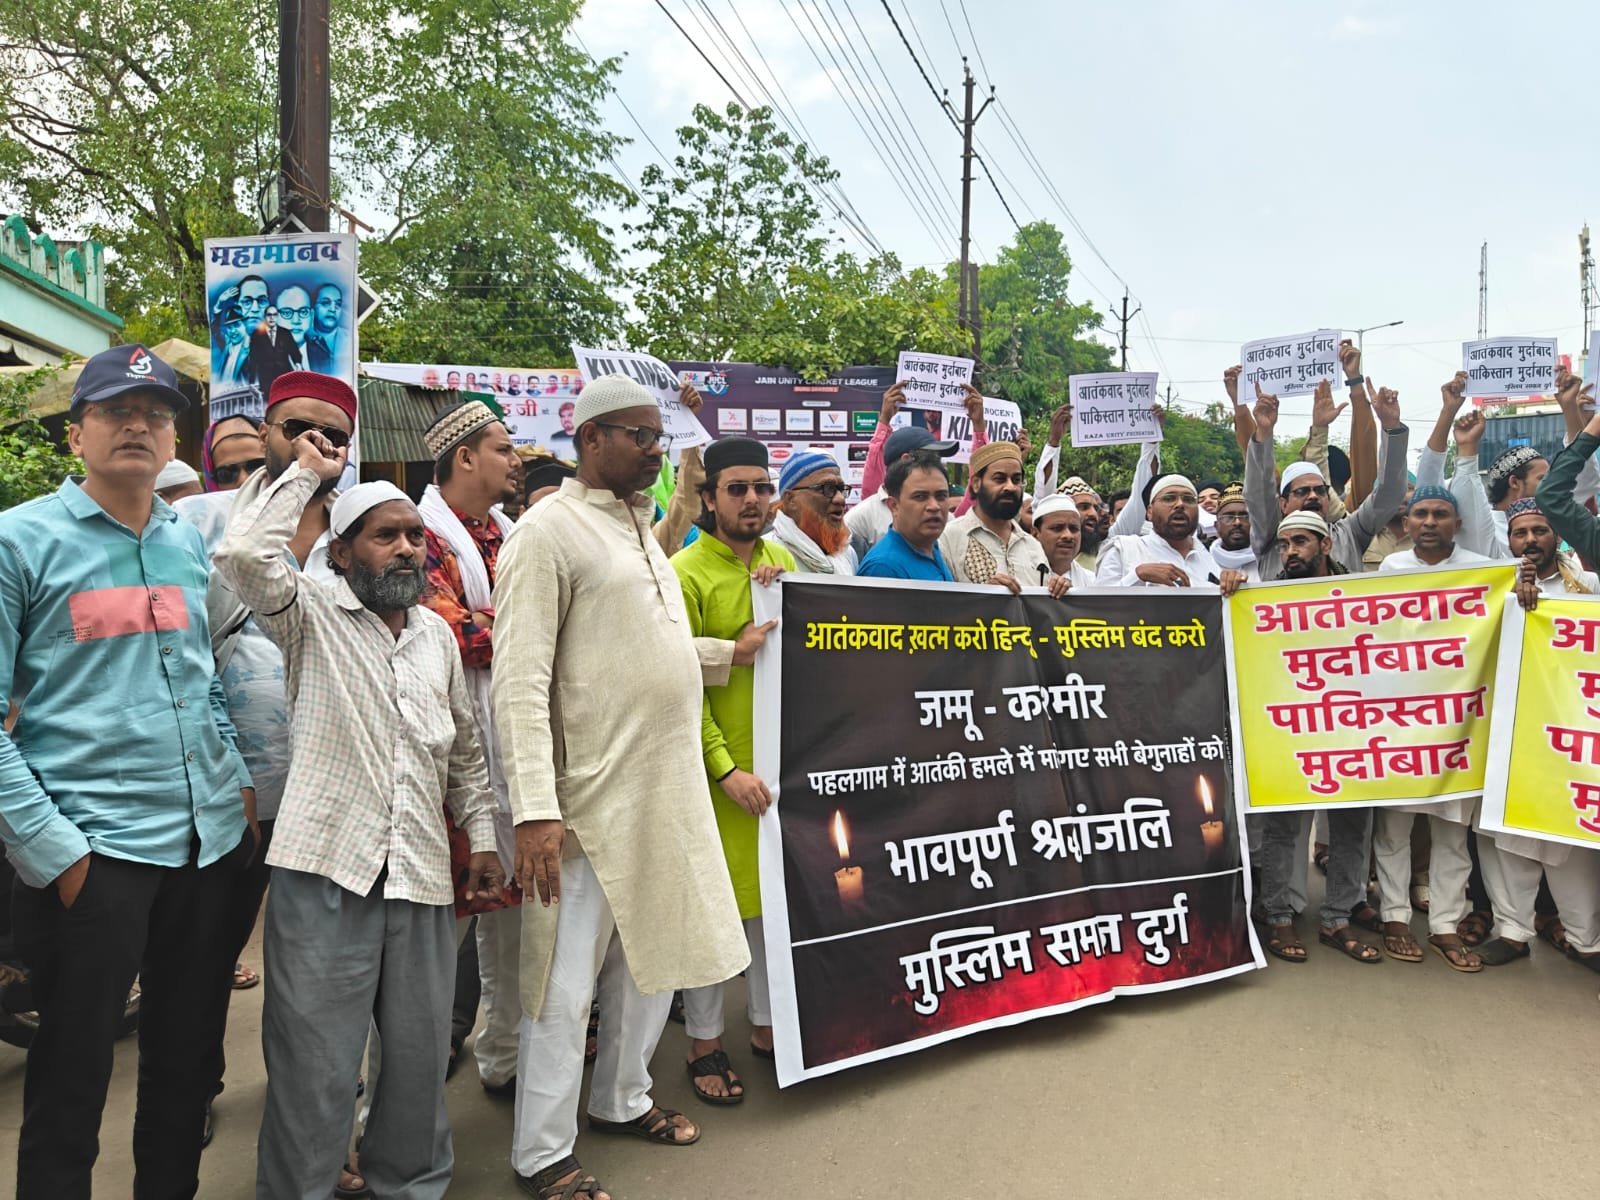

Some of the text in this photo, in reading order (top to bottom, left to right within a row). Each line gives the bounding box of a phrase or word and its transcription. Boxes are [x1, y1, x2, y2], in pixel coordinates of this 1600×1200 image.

[210, 241, 341, 268] महामानव
[1247, 336, 1335, 362] आतंकवाद मुर्दाबाद
[1470, 341, 1552, 361] आतंकवाद मुर्दाबाद
[755, 377, 777, 385] JAIN
[778, 377, 802, 385] UNITY
[844, 378, 878, 386] LEAGUE
[904, 358, 968, 379] आतंकवाद मुर्दाबाद
[1247, 359, 1335, 385] पाकिस्तान मुर्दाबाद
[1469, 362, 1552, 382] पाकिस्तान मुर्दाबाद
[1079, 378, 1150, 403] आतंकवाद मुर्दाबाद
[515, 399, 537, 416] जी
[984, 407, 1015, 418] NOCENT
[1080, 404, 1153, 427] पाकिस्तान मुर्दाबाद
[947, 415, 1018, 443] KILNGS
[1254, 585, 1489, 633] आतंकवाद
[805, 615, 905, 650] आतंकवाद
[908, 625, 950, 655] ख़त्म
[953, 618, 988, 650] करो
[990, 618, 1038, 659] हिन्दू
[1054, 618, 1125, 659] मुस्लिम
[1129, 619, 1162, 648] बंद
[1166, 618, 1206, 647] करो
[1282, 633, 1467, 692] मुर्दाबाद
[914, 689, 985, 741] जम्मू
[1266, 685, 1487, 734] पाकिस्तान
[807, 766, 889, 796] पहलगाम
[892, 756, 906, 786] में
[910, 751, 967, 784] आतंकी
[968, 748, 1015, 780] हमले
[1017, 744, 1036, 772] में
[1093, 740, 1130, 768] सभी
[1131, 736, 1197, 772] बेगुनाहों
[1198, 734, 1224, 761] को
[1296, 736, 1470, 795] मुर्दाबाद
[884, 809, 1019, 889] भावपूर्ण
[900, 925, 1031, 1016] मुस्लिम
[1131, 892, 1189, 965] दुर्ग
